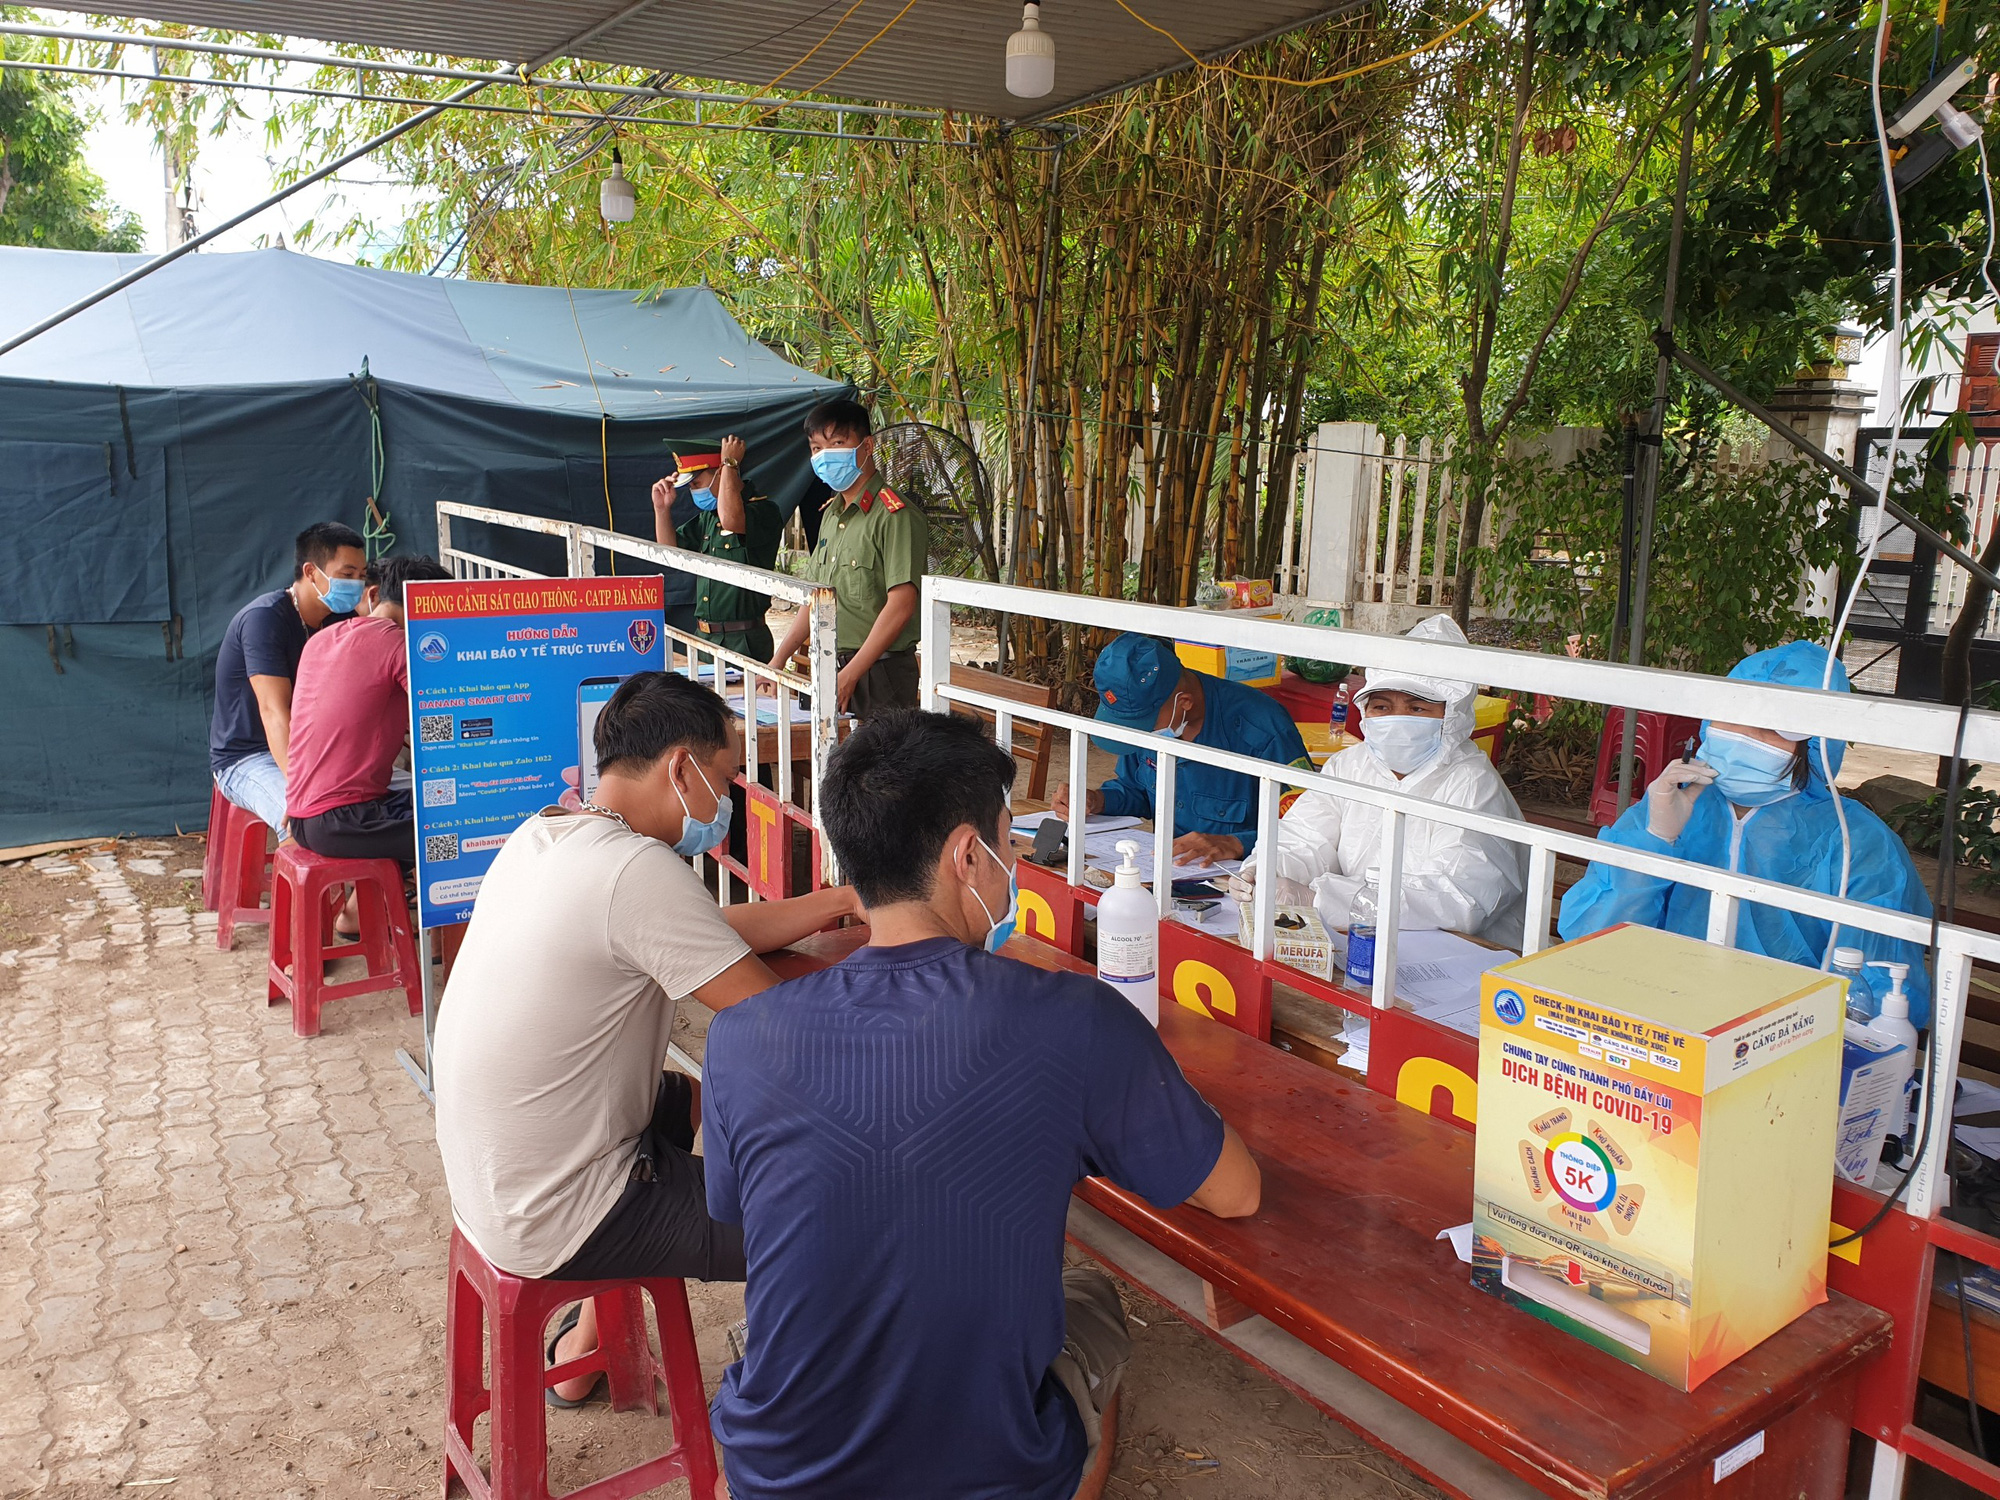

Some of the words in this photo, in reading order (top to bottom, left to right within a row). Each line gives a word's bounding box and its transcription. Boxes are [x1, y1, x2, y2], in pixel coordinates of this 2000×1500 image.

[414, 590, 455, 614] PHÒNG
[456, 586, 488, 612] CẢNH
[490, 588, 511, 611] SÁT
[513, 591, 539, 610] GIAO
[541, 586, 577, 608] THÔNG
[585, 589, 612, 607] CATP
[614, 584, 628, 606] ĐÀ
[506, 627, 549, 642] HƯỚNG
[552, 623, 578, 639] DẪN
[456, 649, 487, 662] KHAI
[490, 646, 517, 660] BÁO
[520, 647, 529, 658] Y
[531, 643, 549, 657] TẾ
[551, 643, 584, 657] TRỰC
[586, 639, 625, 654] TUYẾN
[425, 686, 447, 695] Cách
[449, 686, 457, 694] 1:
[459, 685, 479, 693] Khai
[480, 683, 495, 691] báo
[496, 684, 511, 693] qua
[513, 682, 530, 690] App
[419, 698, 466, 711] DANANG
[468, 695, 505, 706] SMART
[507, 693, 531, 703] CITY
[429, 764, 450, 774] Cách
[452, 764, 460, 772] 2:
[462, 762, 482, 771] Khai
[483, 760, 498, 769] báo
[499, 760, 514, 769] qua
[515, 757, 533, 765] Zalo
[535, 754, 553, 763] 1022
[431, 820, 453, 829] Cách
[454, 819, 462, 827] 3:
[464, 817, 484, 826] Khai
[485, 815, 500, 823] báo
[501, 814, 516, 823] qua
[517, 810, 536, 819] Web
[750, 797, 776, 884] T
[460, 890, 474, 898] thay
[1280, 946, 1324, 958] MERUFA
[1533, 994, 1576, 1016] CHECK-IN
[1577, 1006, 1599, 1022] KHAI
[1602, 1012, 1621, 1029] BÁO
[1623, 1019, 1629, 1031] Y
[1632, 1023, 1645, 1036] TẾ
[1645, 1028, 1650, 1038] /
[1651, 1029, 1670, 1044] THẺ
[1610, 1028, 1634, 1043] KHÔNG
[1634, 1032, 1649, 1046] TIẾP
[1752, 1035, 1776, 1051] CẢNG
[1778, 1023, 1790, 1039] ĐÀ
[1608, 1054, 1628, 1067] SDT
[1653, 1054, 1679, 1068] 1022
[1502, 1042, 1533, 1061] CHUNG
[1534, 1052, 1549, 1067] TAY
[1551, 1059, 1577, 1077] CÙNG
[1578, 1068, 1610, 1088] THÀNH
[1611, 1079, 1633, 1096] PHỐ
[1634, 1087, 1654, 1104] ĐẨY
[1655, 1095, 1673, 1110] LÙI
[1501, 1057, 1539, 1087] DỊCH
[1543, 1071, 1588, 1105] BỆNH
[1592, 1090, 1674, 1136] COVID-19
[1533, 1119, 1552, 1134] KHẨU
[1549, 1112, 1568, 1126] TRANG
[1525, 1146, 1535, 1164] CÁCH
[1559, 1151, 1585, 1166] THÔNG
[1585, 1161, 1602, 1172] ĐIỆP
[1604, 1143, 1625, 1166] KHUẨN
[1564, 1165, 1595, 1195] 5K
[1561, 1204, 1578, 1220] KHAI
[1569, 1220, 1574, 1229] Y
[1575, 1222, 1583, 1233] TẾ
[1491, 1207, 1507, 1221] Vui
[1564, 1241, 1581, 1254] QR
[1601, 1256, 1620, 1272] khe
